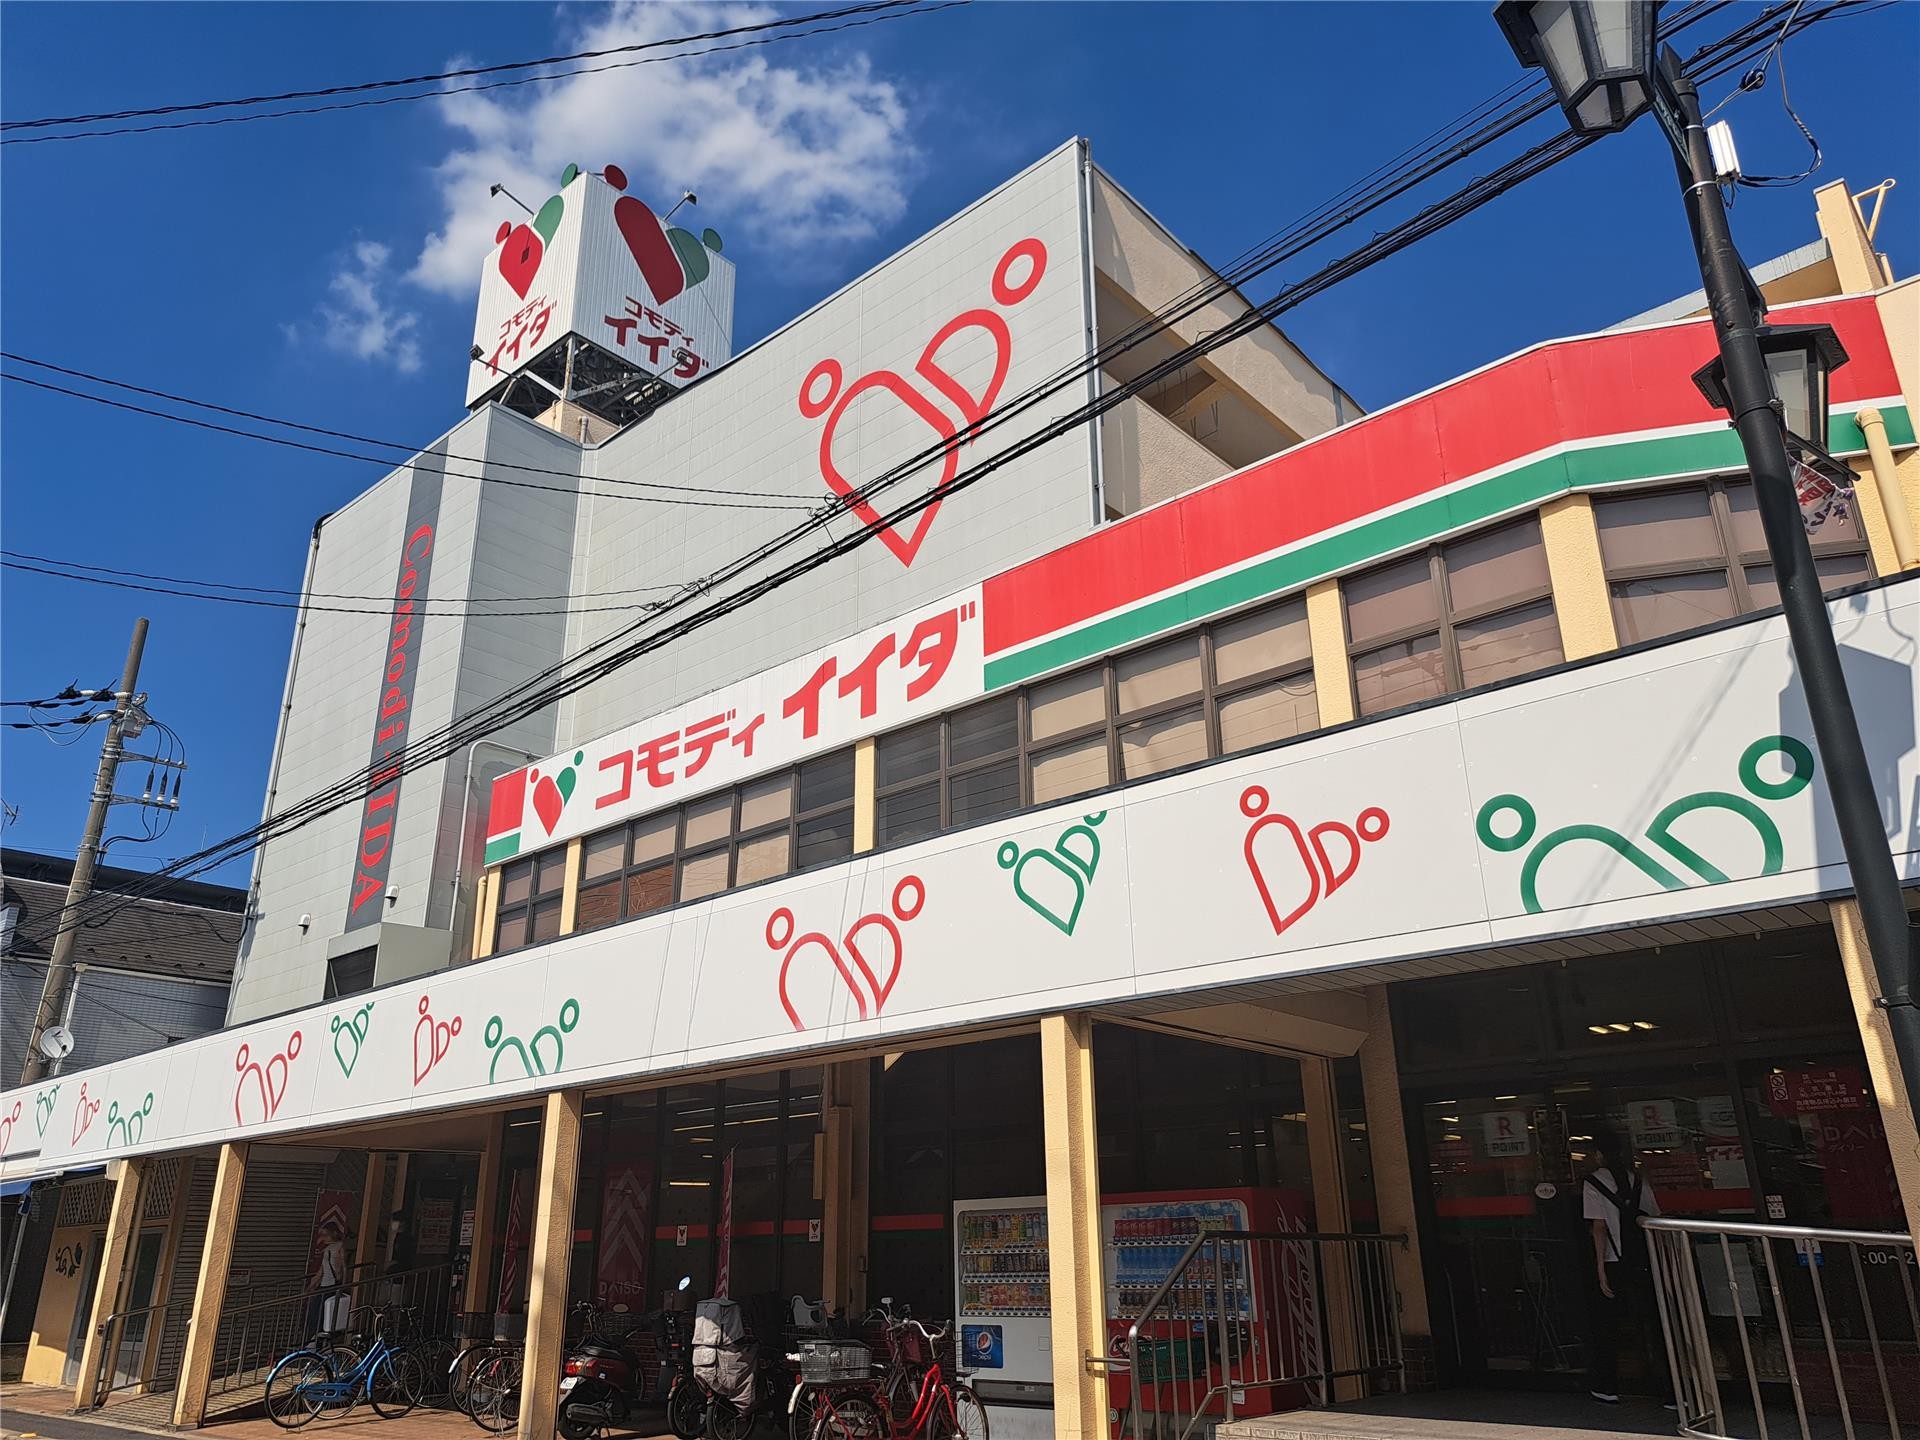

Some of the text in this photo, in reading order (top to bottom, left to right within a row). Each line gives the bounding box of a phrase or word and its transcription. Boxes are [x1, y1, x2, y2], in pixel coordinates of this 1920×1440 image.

[484, 300, 559, 377] イイダ
[498, 294, 548, 341] コモディ
[603, 314, 710, 379] イイダ
[624, 294, 695, 347] コモディ
[375, 523, 434, 747] Comodi
[594, 600, 977, 811] コモディ イイダ
